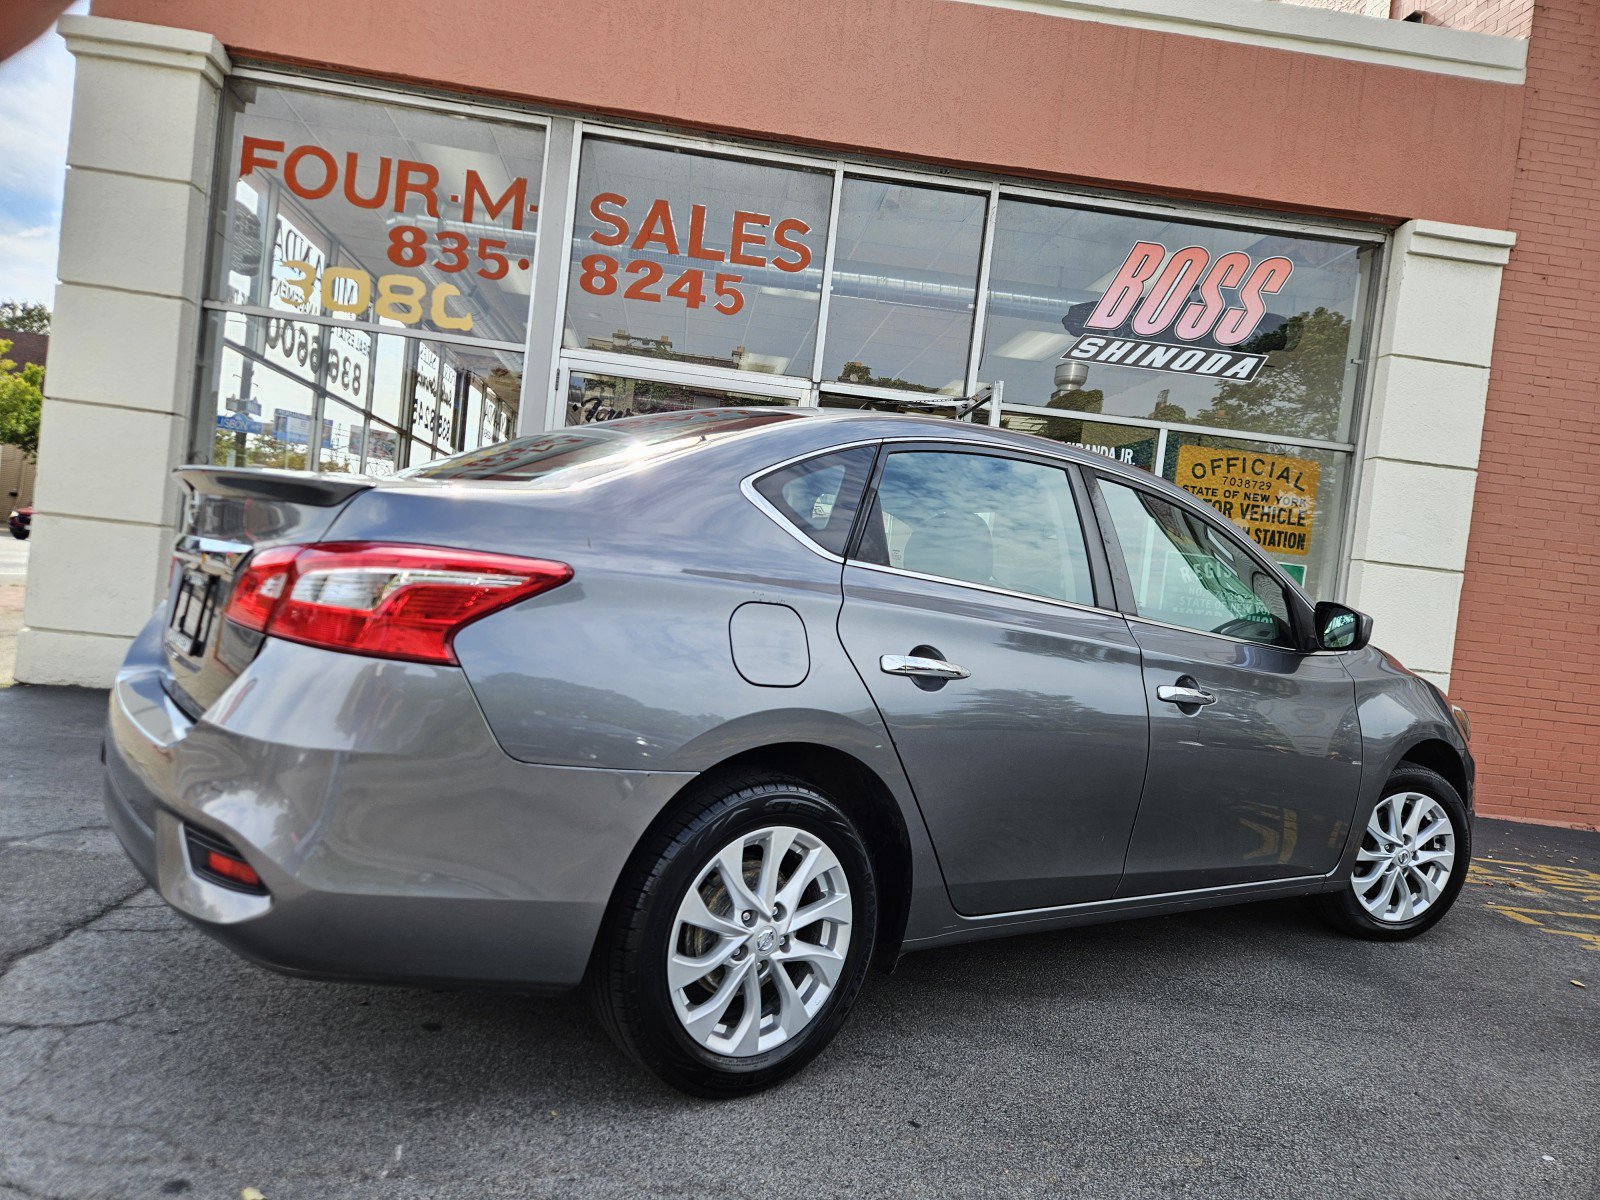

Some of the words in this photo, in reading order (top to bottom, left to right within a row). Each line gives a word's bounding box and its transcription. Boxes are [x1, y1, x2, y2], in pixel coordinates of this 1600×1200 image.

[589, 192, 813, 273] SALES
[579, 253, 746, 316] 8245
[1084, 240, 1294, 346] BOSS
[1071, 337, 1259, 379] SHINODA
[1191, 457, 1306, 492] OFFICIAL
[1222, 476, 1272, 491] 7038729
[1182, 484, 1219, 497] STATE
[1223, 489, 1240, 499] OF
[1243, 491, 1271, 503] NEW
[1275, 495, 1308, 508] YORK
[1240, 502, 1307, 527] VEHICLE
[1254, 527, 1307, 550] STATION
